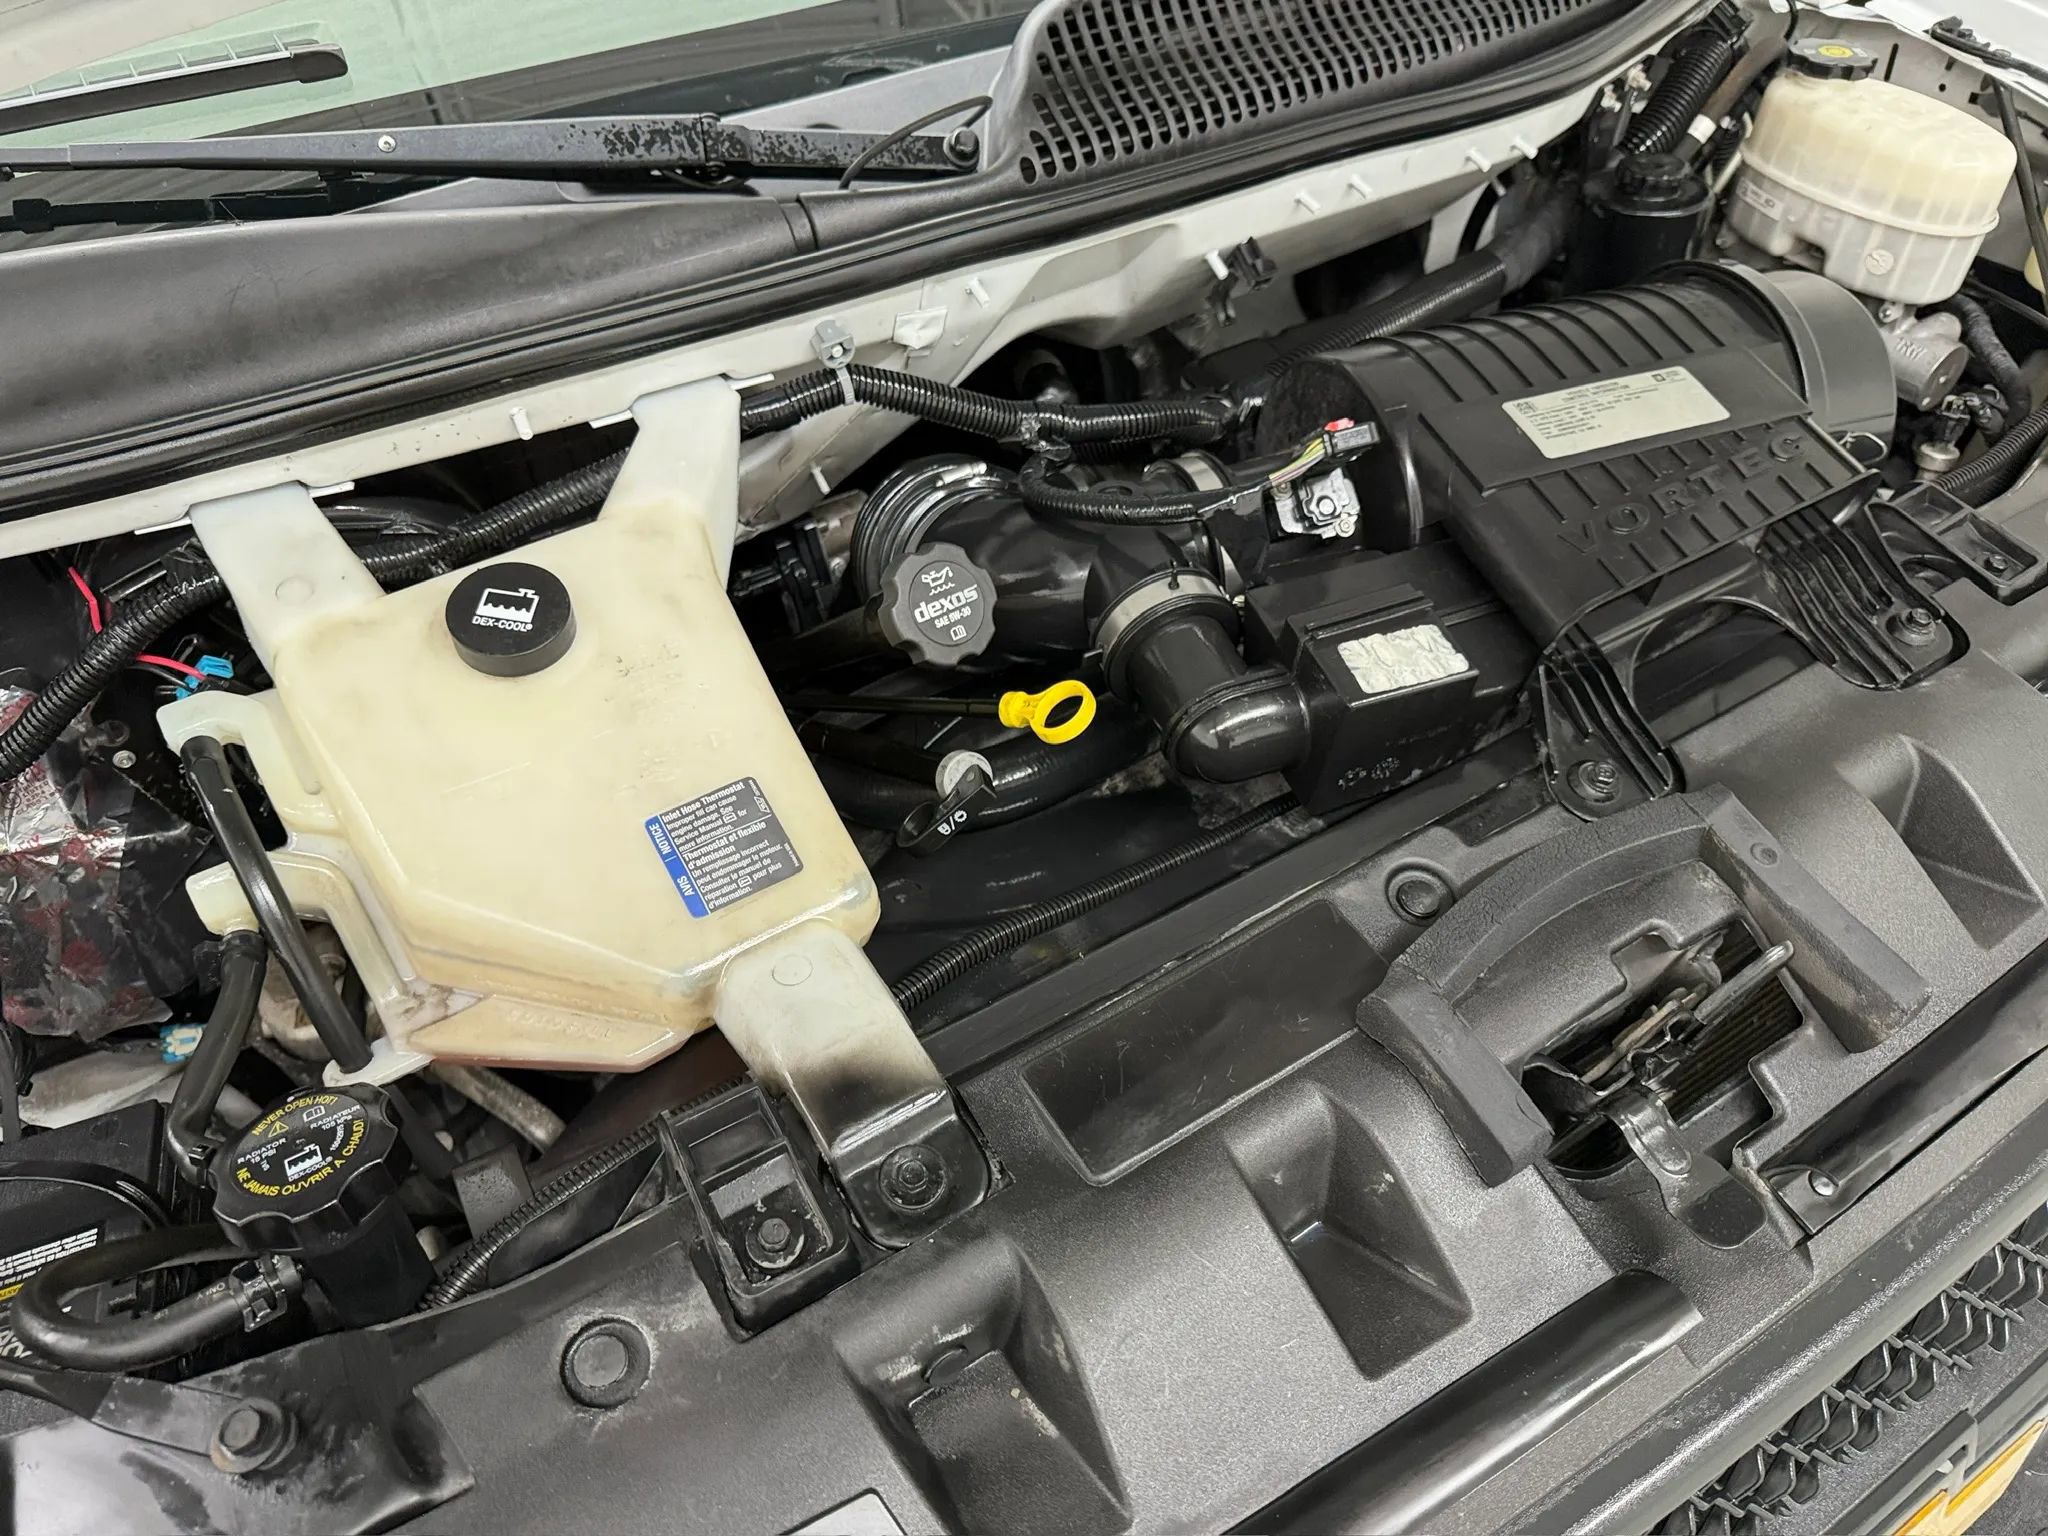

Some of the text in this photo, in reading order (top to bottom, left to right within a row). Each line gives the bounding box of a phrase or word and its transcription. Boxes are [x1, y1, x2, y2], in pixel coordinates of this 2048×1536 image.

[1557, 431, 1802, 553] VORTEC
[914, 584, 978, 623] dexos
[934, 615, 950, 628] SAE
[662, 809, 682, 823] Inlet
[680, 800, 702, 815] Hose
[700, 781, 745, 806] Thermostat
[666, 813, 696, 831] Improper
[704, 803, 718, 813] can
[717, 795, 737, 807] cause
[670, 804, 734, 839] engine damage. See
[673, 807, 748, 845] Service Manual for
[678, 823, 734, 852] more information.
[648, 822, 672, 855] NOTICE
[682, 820, 767, 862] Thermostat et flexible
[687, 843, 736, 870] d'admission
[691, 868, 702, 878] Un
[701, 852, 741, 874] remplissage
[740, 839, 770, 857] incorrect
[696, 874, 712, 886] peut
[710, 856, 752, 880] endommager
[751, 853, 759, 861] le
[759, 843, 783, 858] moteur.
[676, 875, 695, 896] AVIS
[700, 857, 772, 894] Consulter le manuel de
[704, 861, 783, 902] réparation pour plus
[708, 885, 753, 909] d'information.
[251, 1109, 286, 1136] NEVER
[285, 1097, 313, 1112] OPEN
[310, 1104, 360, 1129] RADIATEUR
[321, 1121, 336, 1131] 105
[237, 1137, 287, 1164] RADIATOR
[250, 1148, 277, 1164] 15 PSI
[236, 1167, 251, 1183] NE
[243, 1180, 280, 1196] JAMAIS
[281, 1166, 334, 1195] OUVRIR
